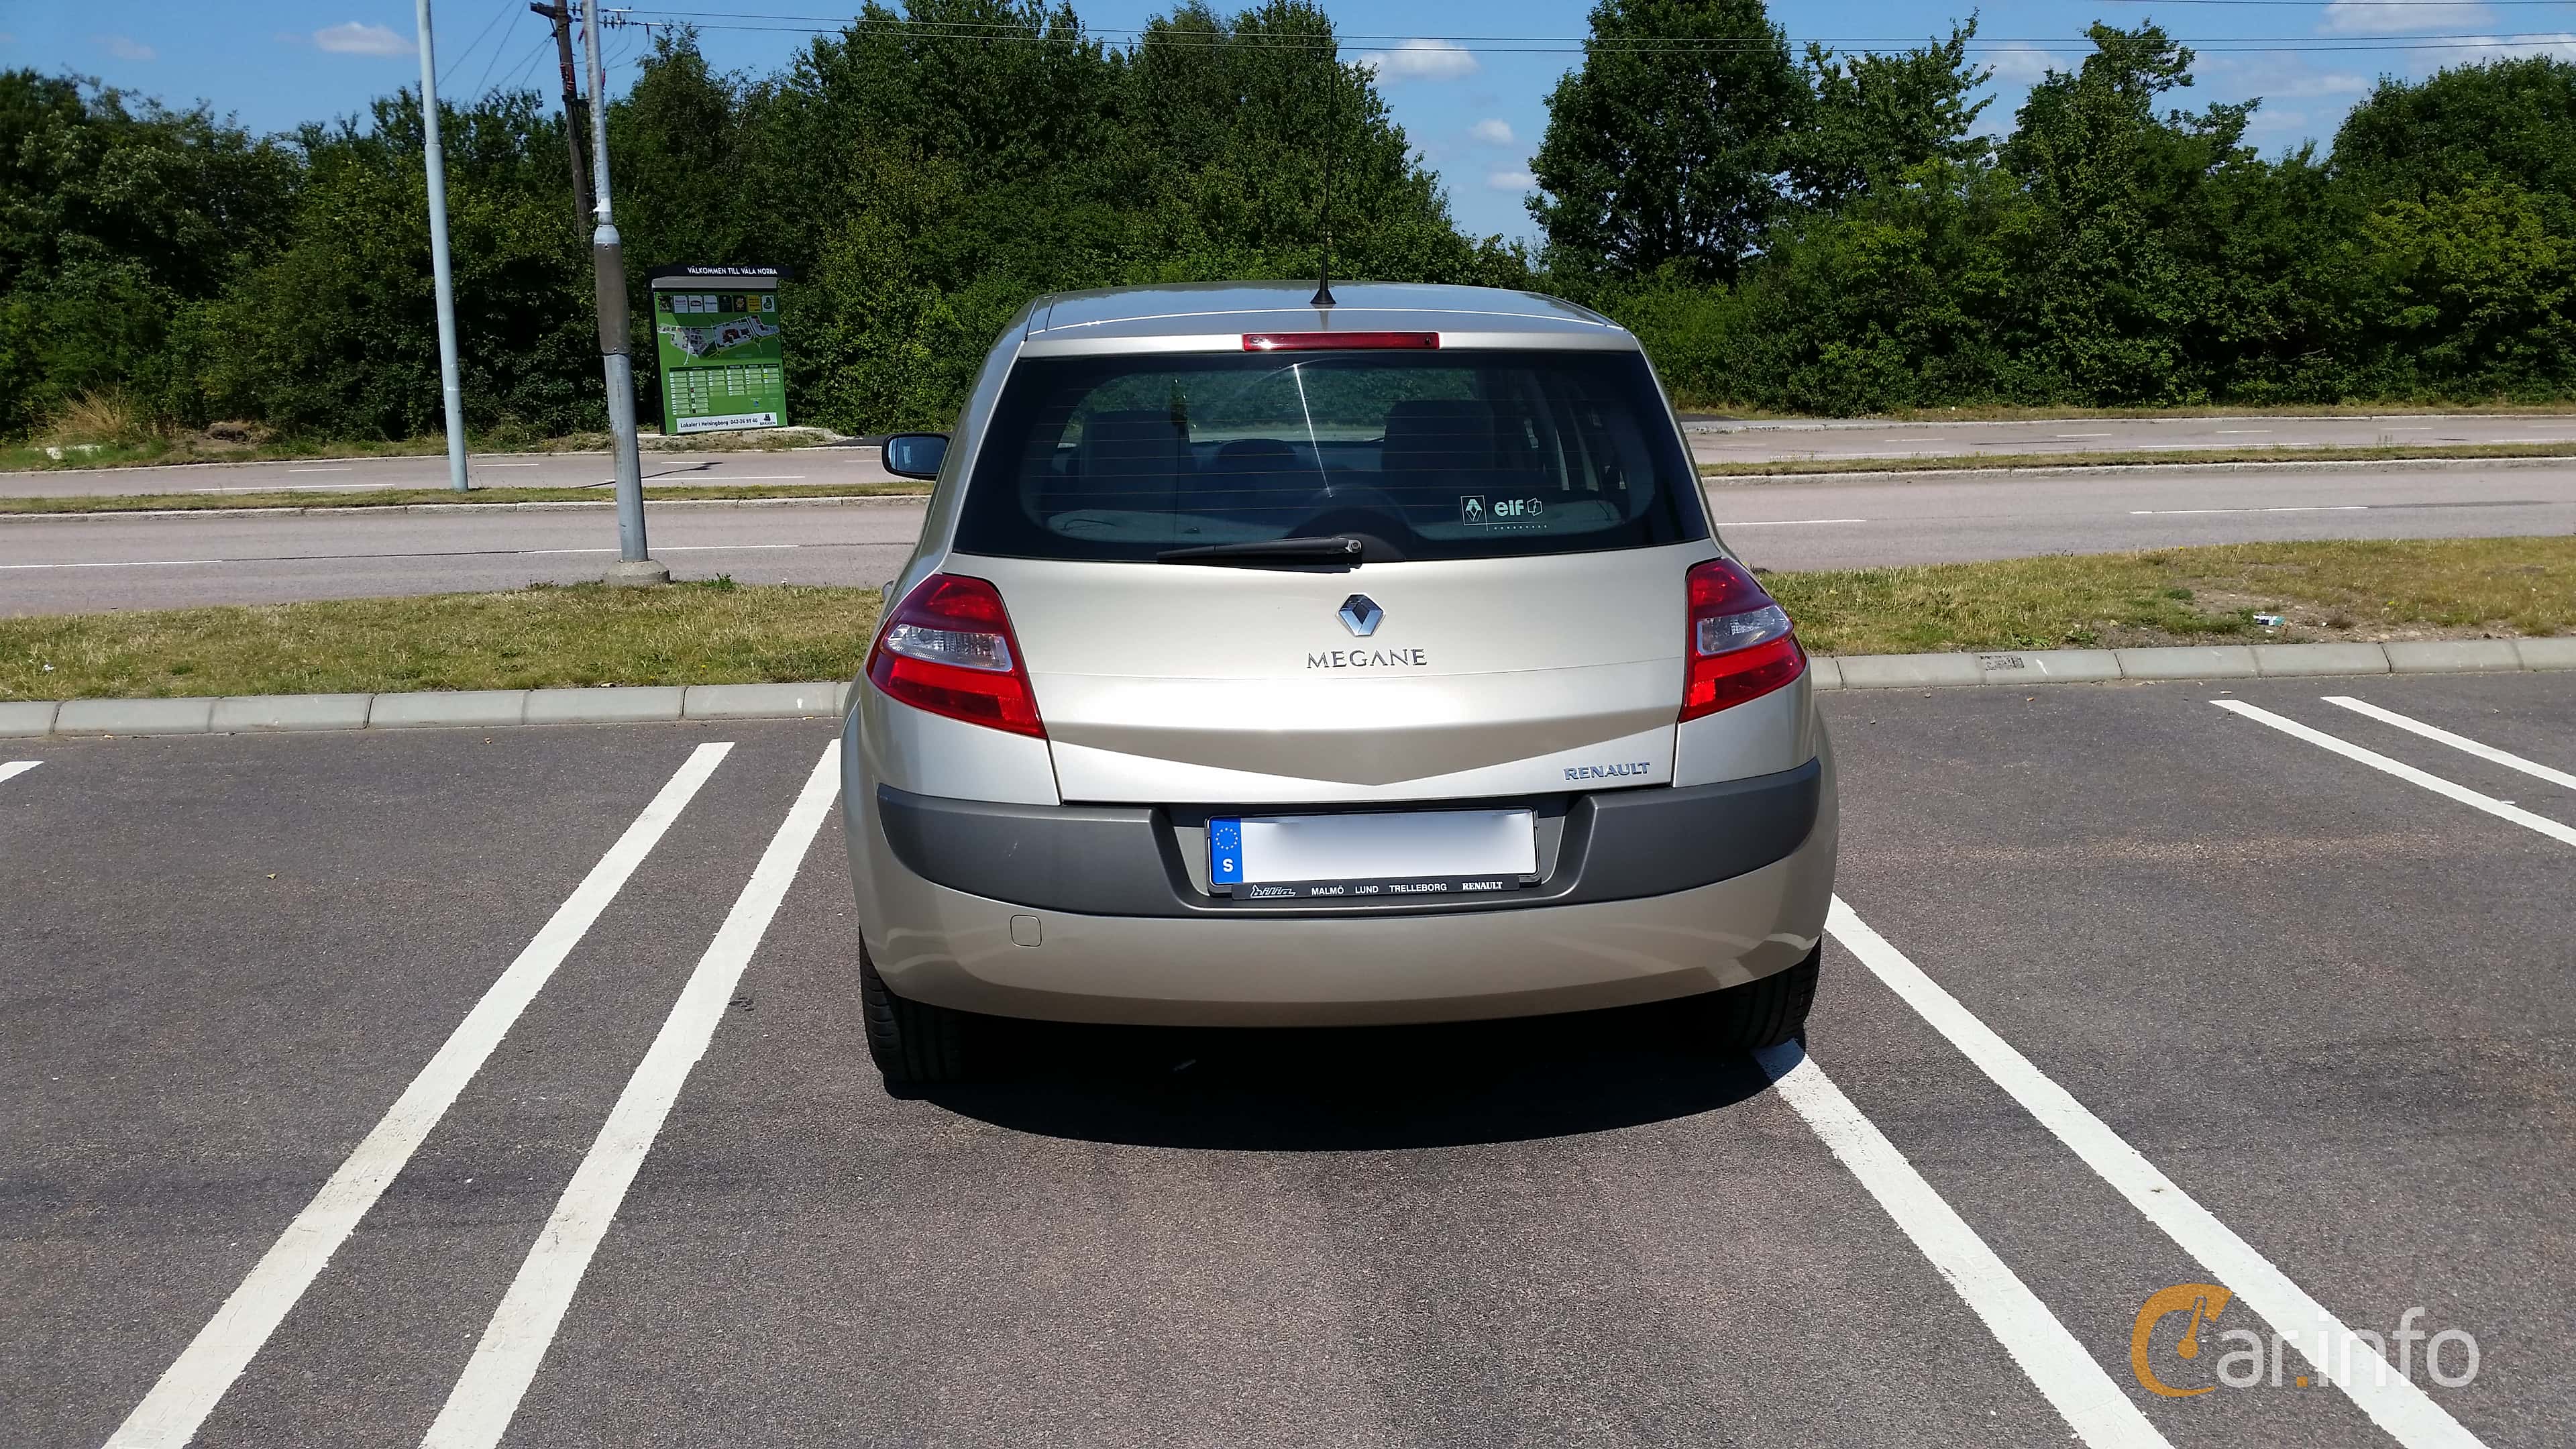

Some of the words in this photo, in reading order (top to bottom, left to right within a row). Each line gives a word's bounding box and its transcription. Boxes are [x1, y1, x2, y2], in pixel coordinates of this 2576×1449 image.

[687, 266, 727, 274] VÄLKOMMEN
[1494, 498, 1525, 517] elf
[1307, 648, 1428, 669] MEGANE
[1563, 761, 1651, 781] RENAULT
[1222, 858, 1234, 873] S
[1311, 885, 1344, 896] MALMÖ
[1354, 885, 1379, 894] LUND
[1389, 882, 1448, 893] TRELLEBORG
[1462, 881, 1503, 891] RENAULT
